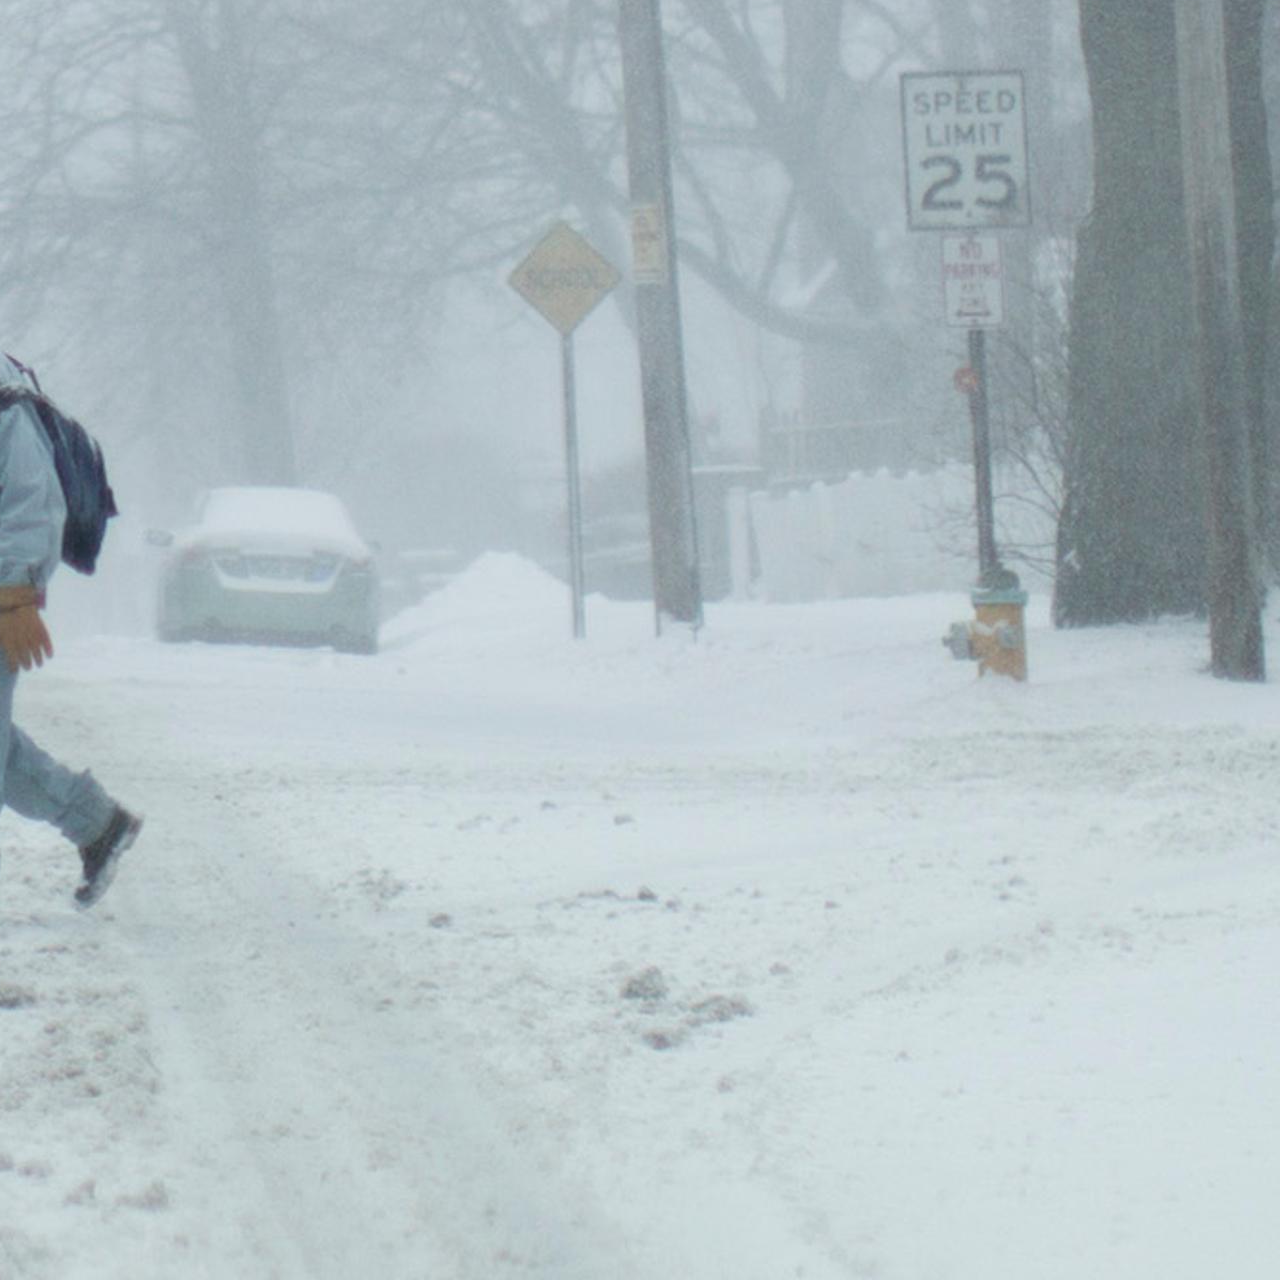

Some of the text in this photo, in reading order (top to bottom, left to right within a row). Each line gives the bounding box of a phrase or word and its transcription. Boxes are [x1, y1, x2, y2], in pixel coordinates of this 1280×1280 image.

[914, 90, 1016, 115] SPEED
[925, 122, 1004, 147] LIMIT
[920, 154, 1019, 210] 25
